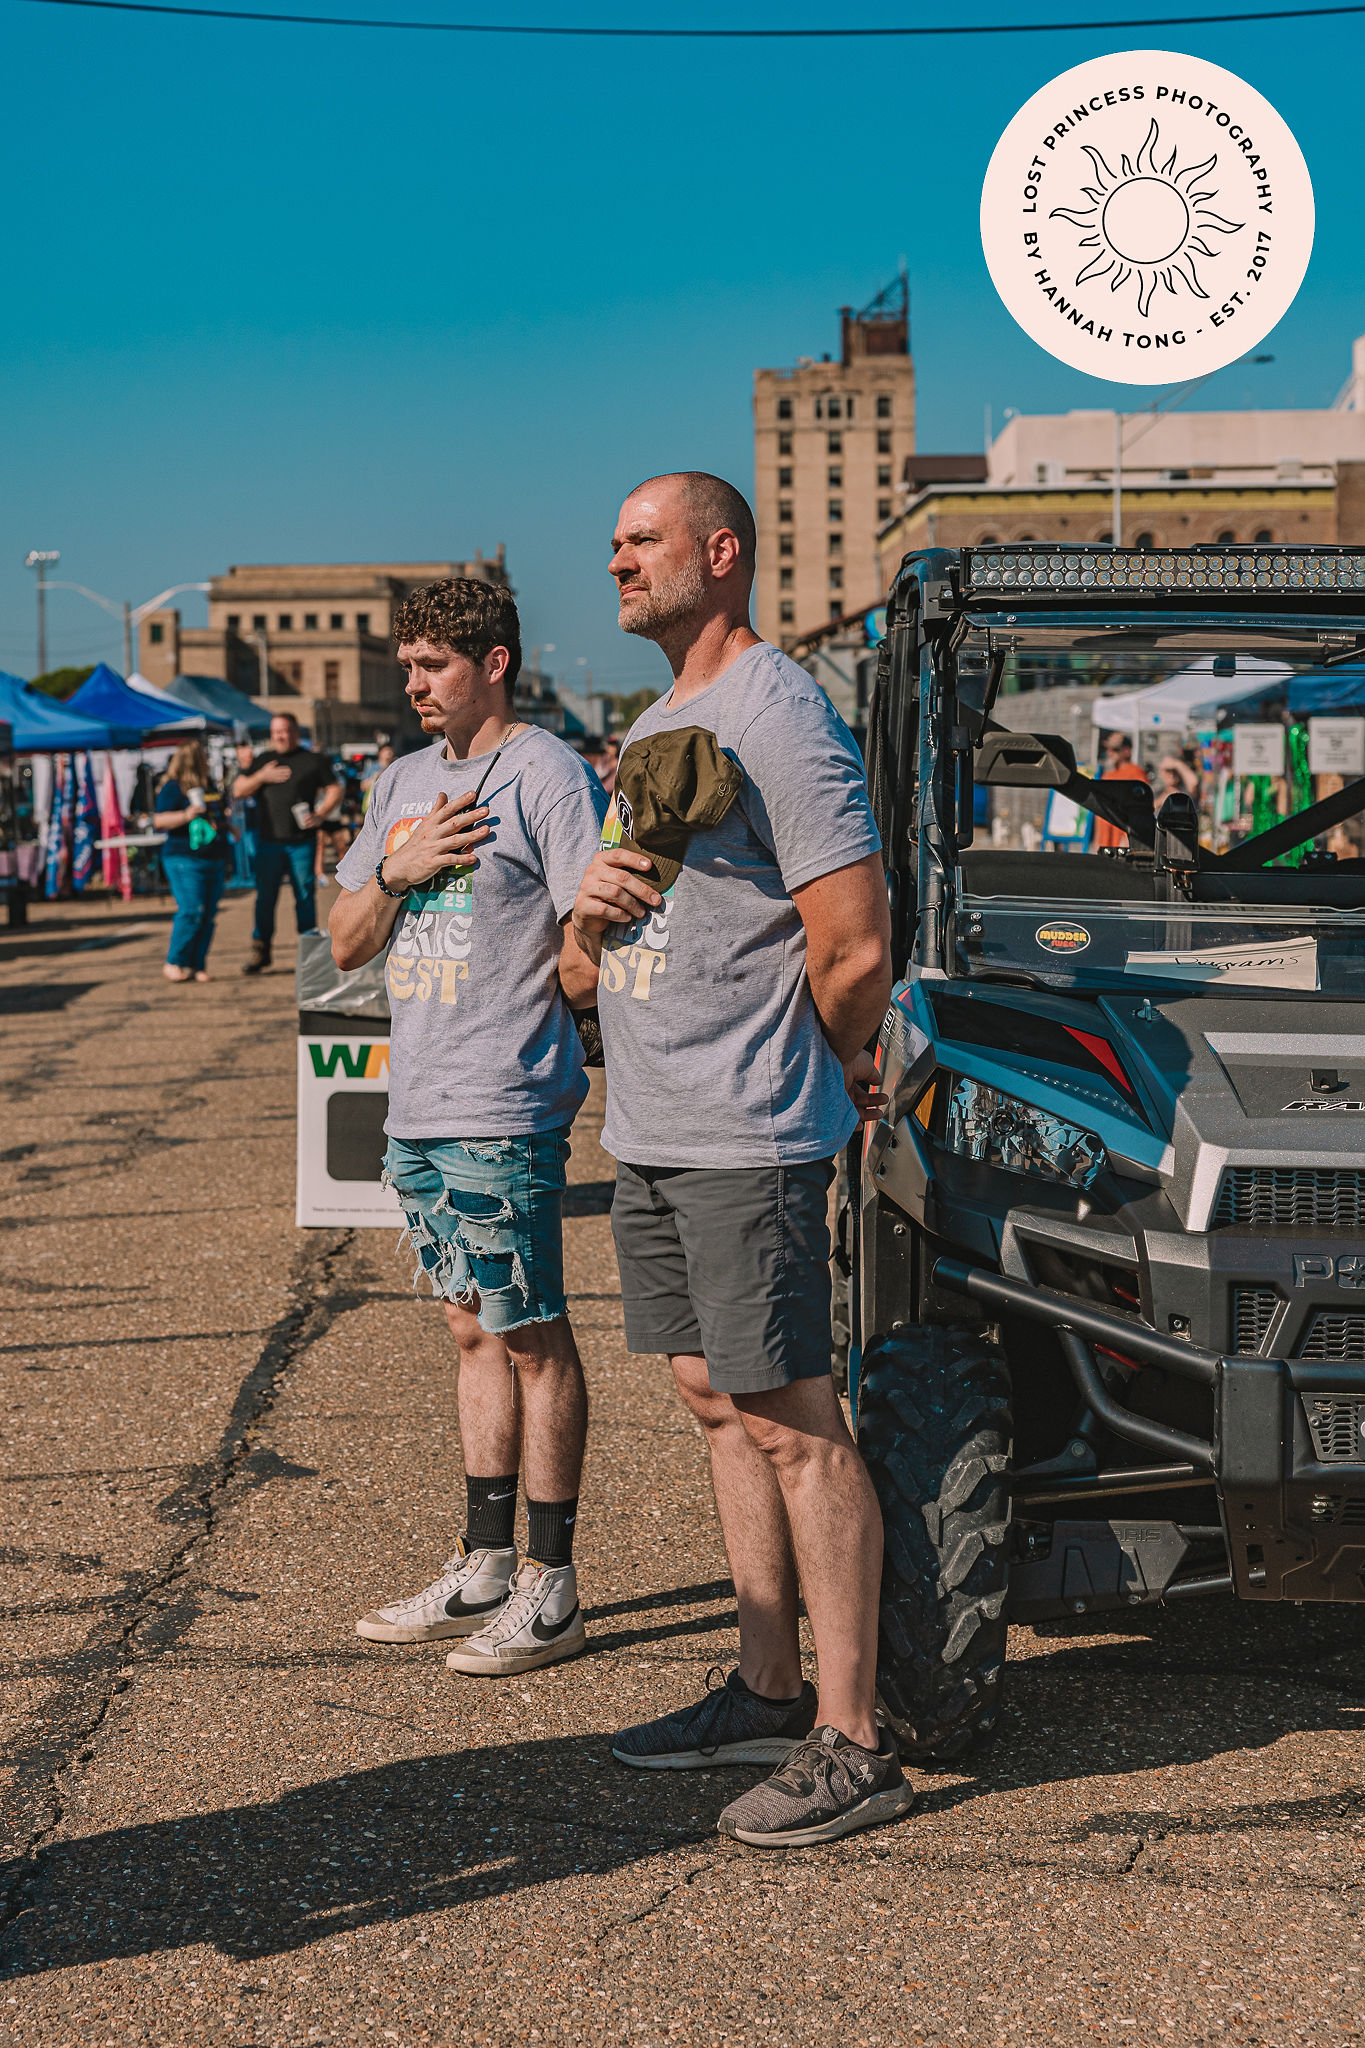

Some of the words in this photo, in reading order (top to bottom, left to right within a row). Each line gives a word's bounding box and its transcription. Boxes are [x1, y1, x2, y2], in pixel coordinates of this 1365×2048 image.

[400, 801, 434, 816] TEXA
[445, 877, 467, 892] 20
[443, 893, 467, 908] 25
[1039, 930, 1087, 942] MUDDER
[386, 954, 470, 1005] EST
[1281, 1100, 1365, 1111] RA
